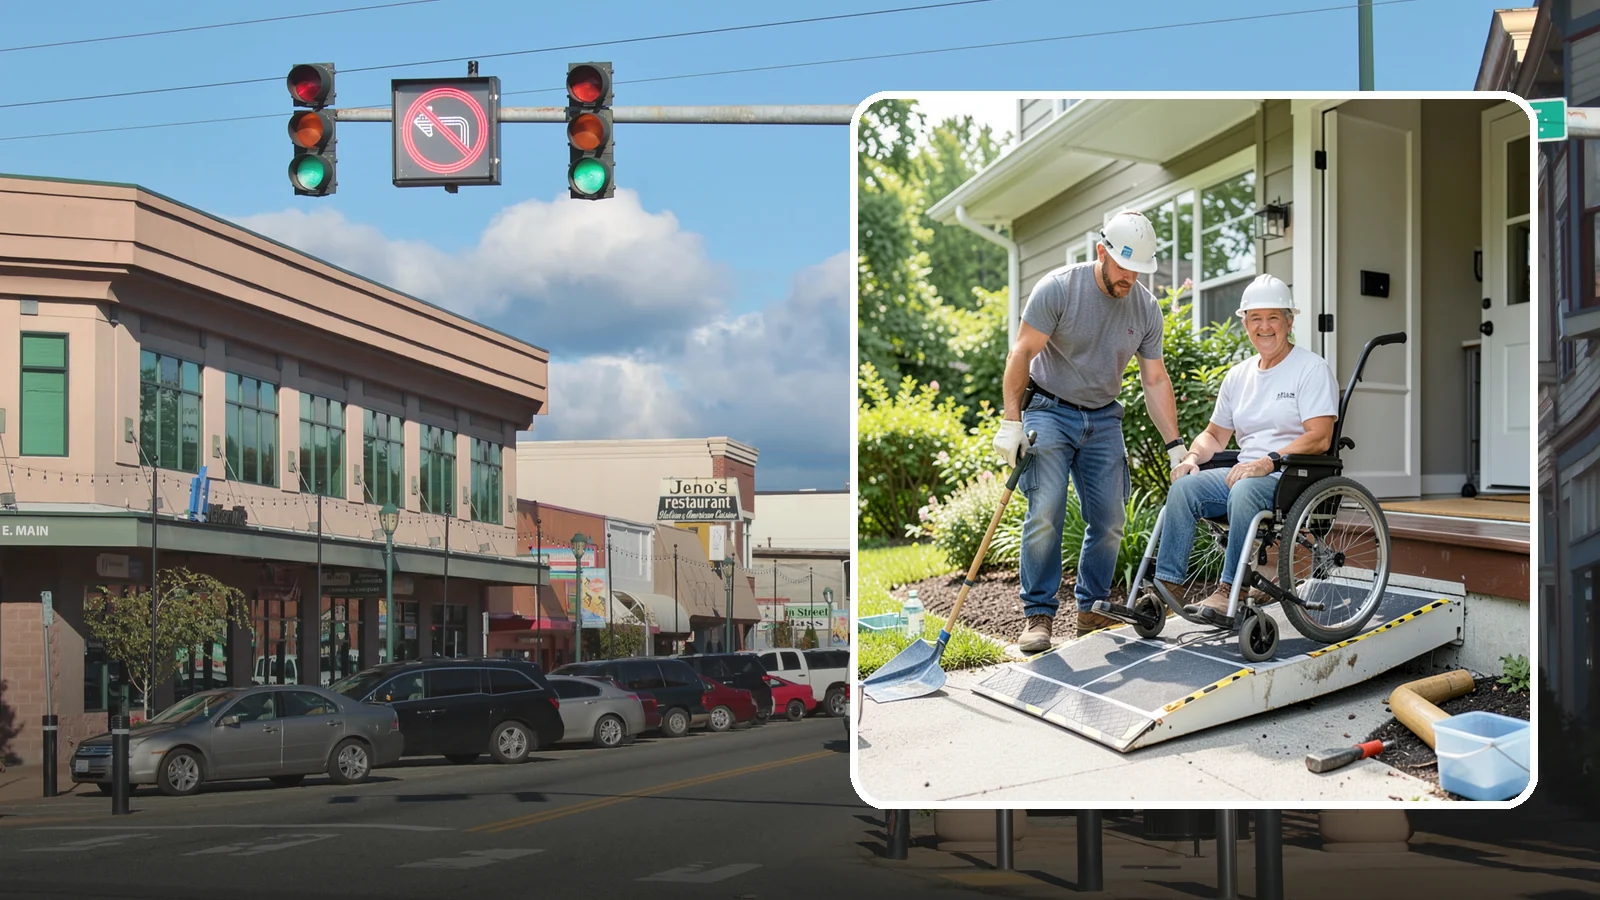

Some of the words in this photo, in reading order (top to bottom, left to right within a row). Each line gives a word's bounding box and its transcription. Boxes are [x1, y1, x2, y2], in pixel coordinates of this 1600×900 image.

[670, 480, 728, 494] Jeno's
[665, 496, 731, 509] restaurant
[658, 510, 681, 519] Italian
[685, 509, 714, 519] American
[714, 509, 737, 519] Cuisine
[2, 525, 13, 536] E.
[15, 525, 49, 536] MAIN
[797, 607, 828, 616] Street
